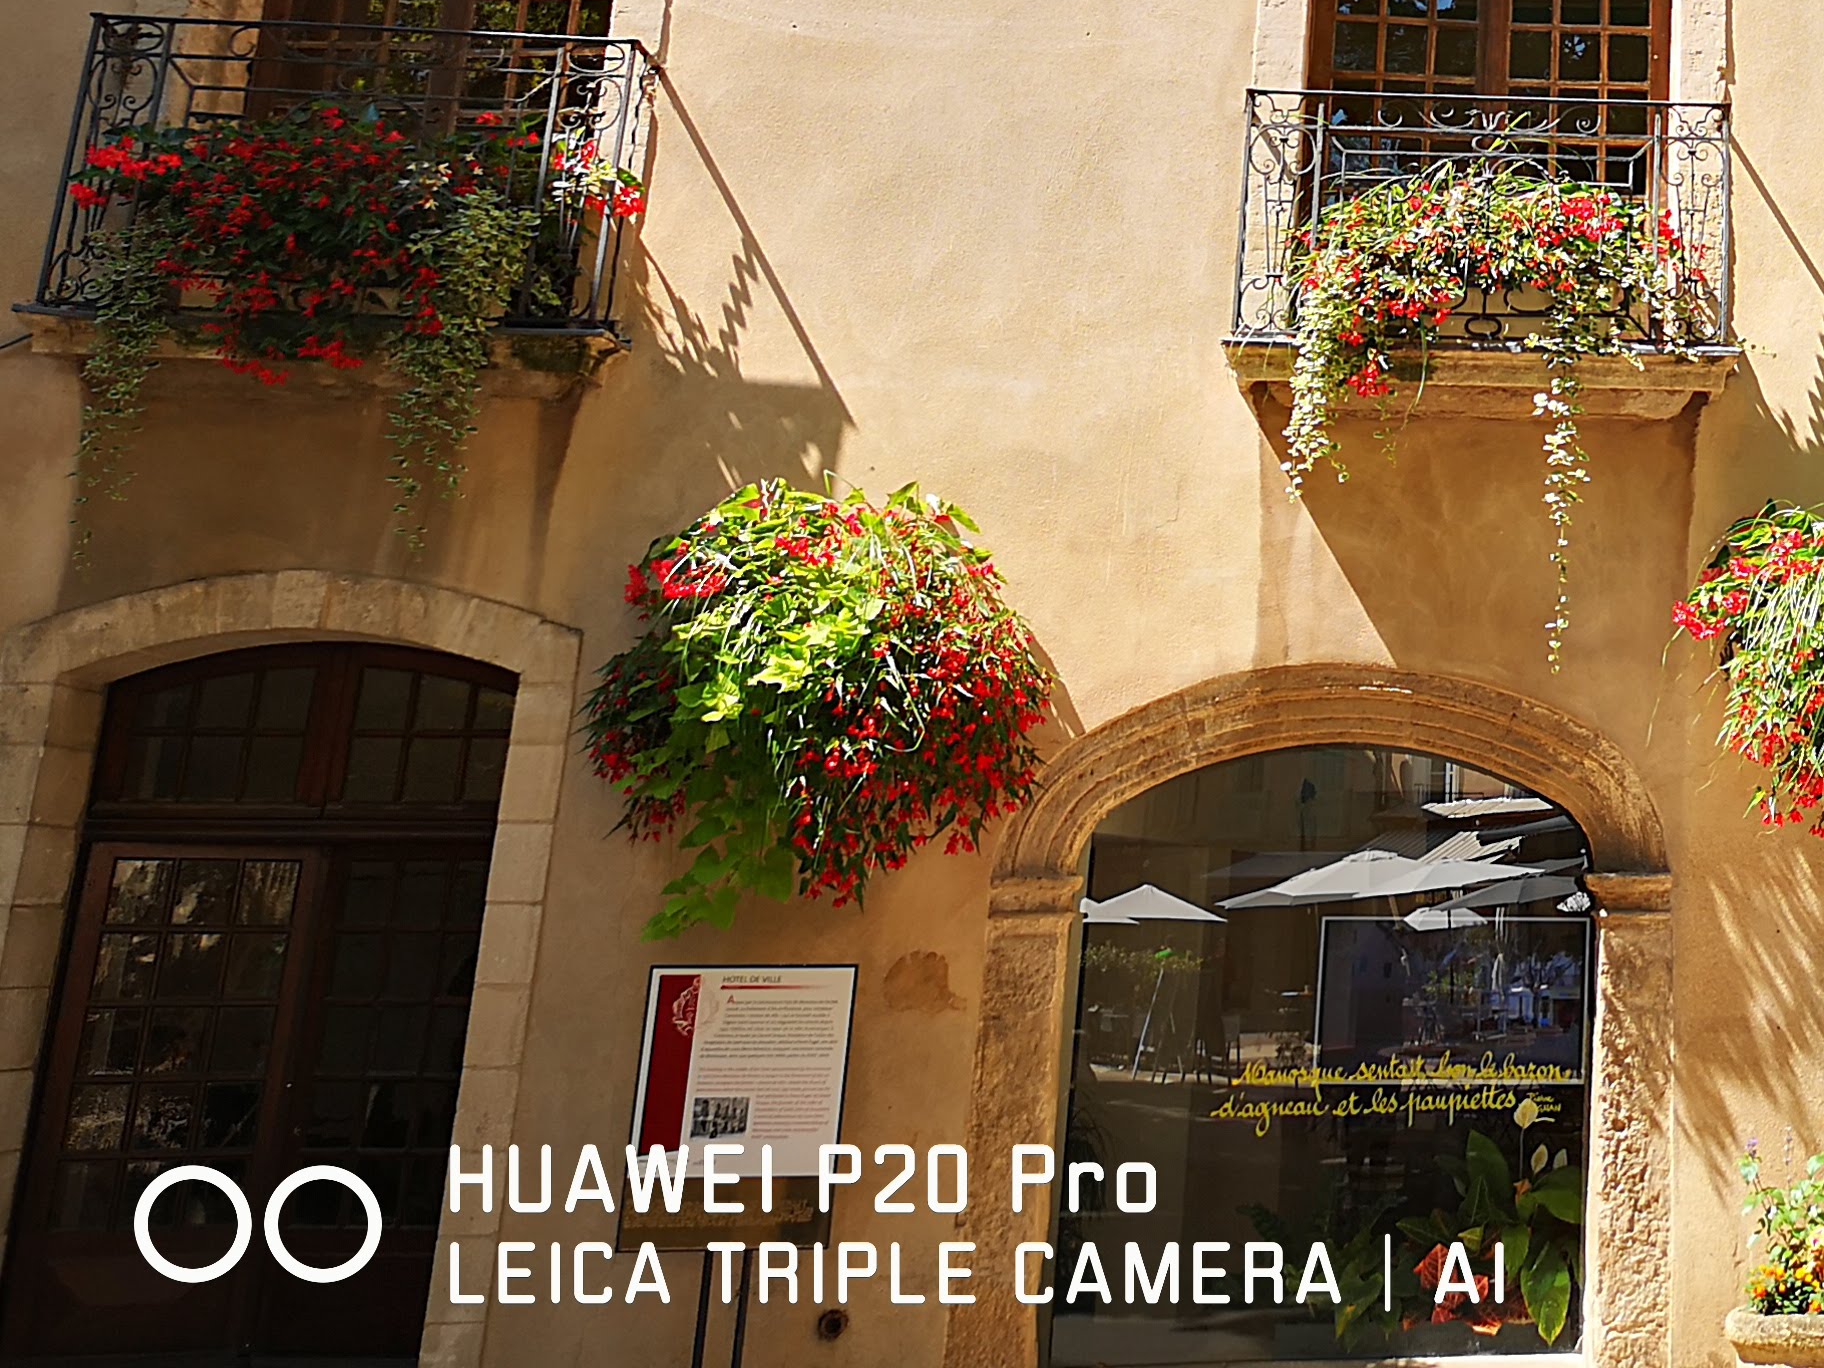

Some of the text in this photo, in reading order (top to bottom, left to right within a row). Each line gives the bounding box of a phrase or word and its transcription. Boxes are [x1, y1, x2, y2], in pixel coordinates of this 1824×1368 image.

[1210, 1084, 1516, 1137] d'agneau et les paupiettes
